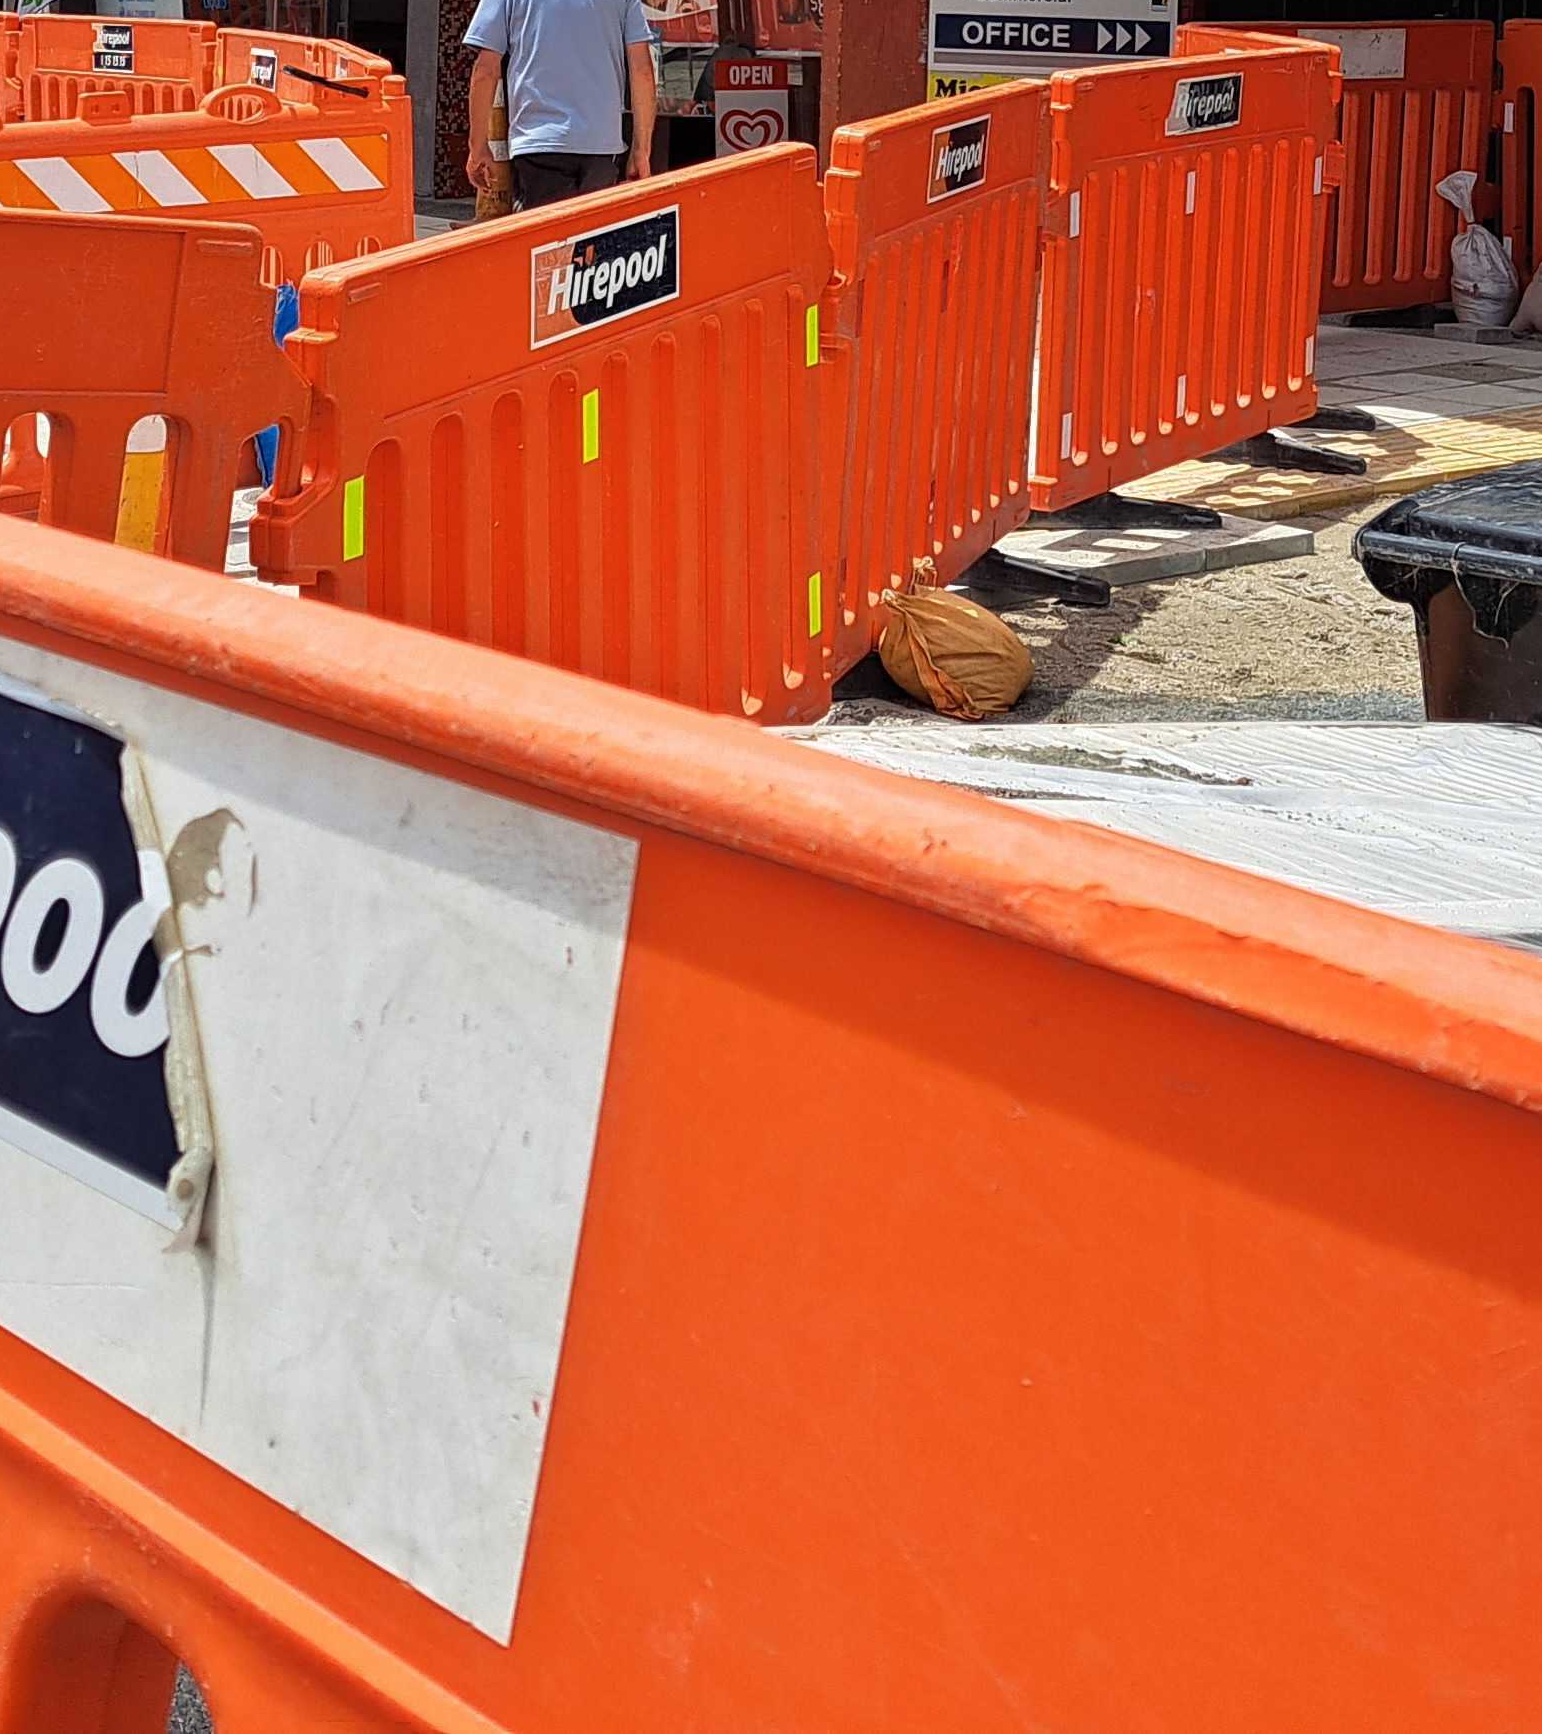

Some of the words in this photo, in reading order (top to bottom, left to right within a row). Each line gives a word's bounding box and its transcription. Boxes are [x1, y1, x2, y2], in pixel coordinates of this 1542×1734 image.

[962, 20, 1071, 48] OFFICE
[729, 65, 774, 85] OPEN
[1175, 87, 1235, 122] Hirepool
[935, 134, 985, 182] Hirepool
[546, 234, 667, 316] Hirepool
